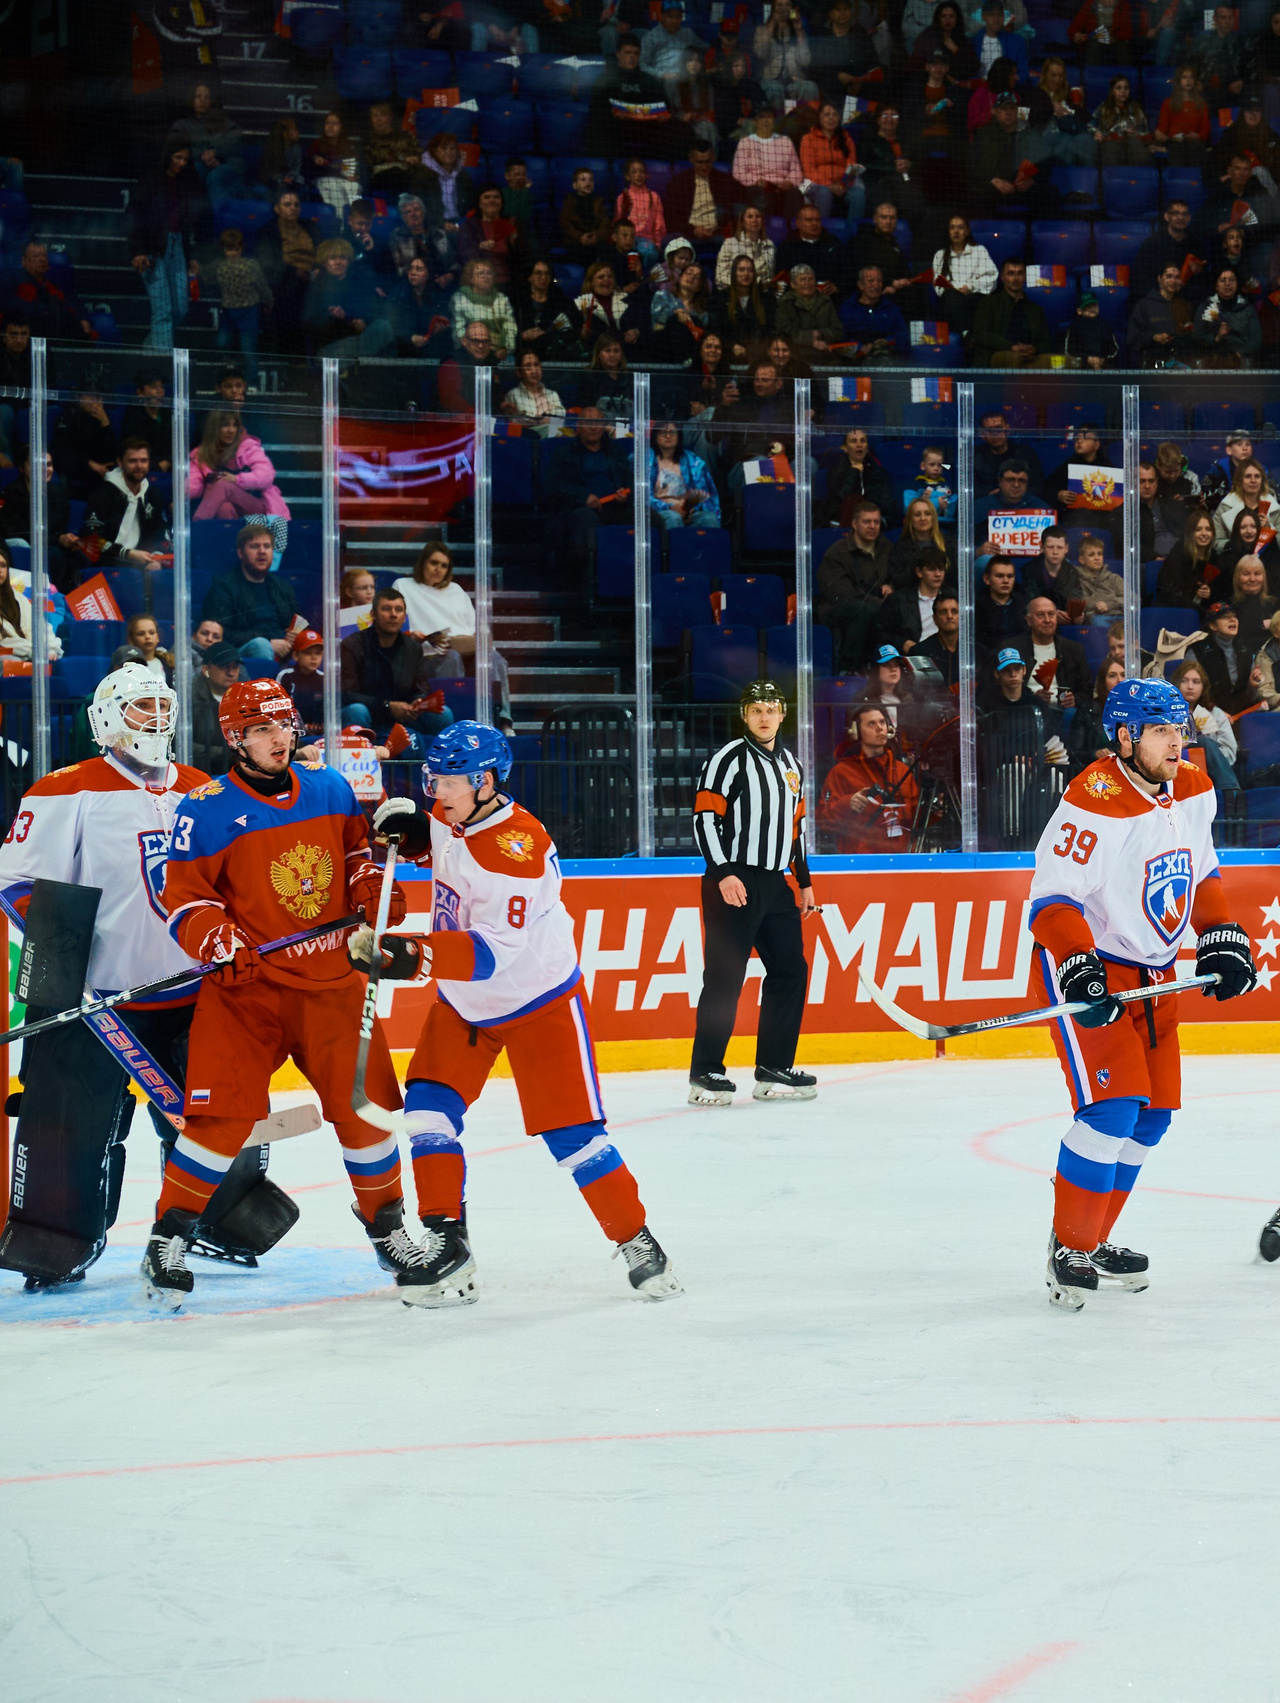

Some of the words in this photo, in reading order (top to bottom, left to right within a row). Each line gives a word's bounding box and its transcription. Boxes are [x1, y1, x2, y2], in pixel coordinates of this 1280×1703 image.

[241, 41, 267, 60] 17
[287, 94, 313, 111] 16
[257, 371, 280, 393] 11
[262, 701, 292, 713] РОЛЬФ
[478, 756, 497, 768] CCM
[1053, 821, 1098, 865] 39
[1149, 853, 1189, 879] СХЛ
[507, 895, 527, 929] 8
[18, 939, 36, 1000] BAUER
[359, 981, 378, 1040] CCM
[90, 1012, 180, 1107] BAUER
[13, 1143, 29, 1210] BAUER
